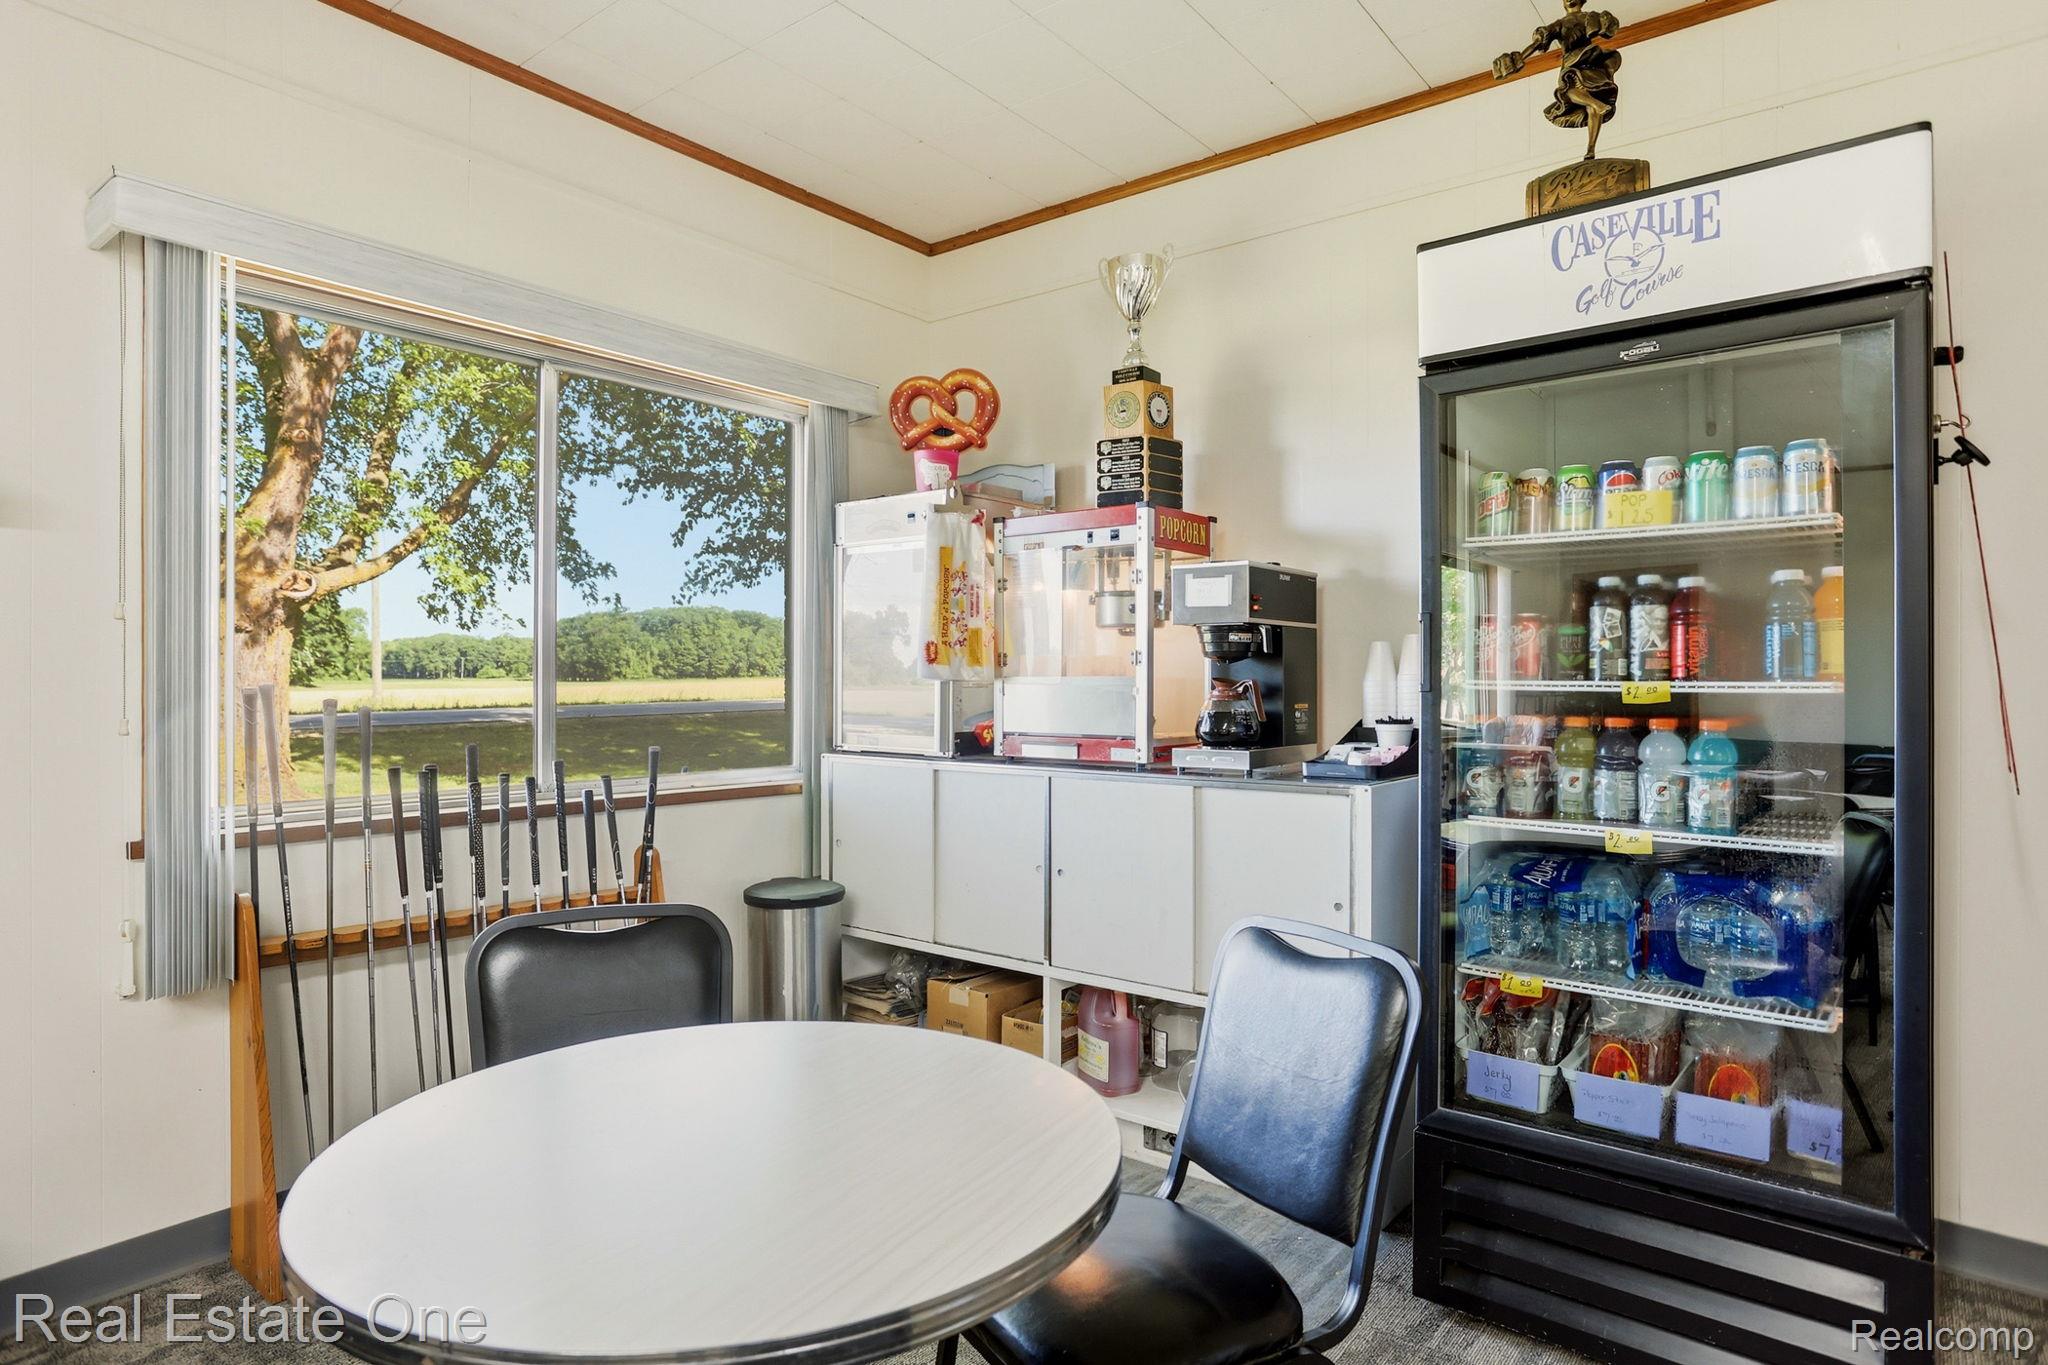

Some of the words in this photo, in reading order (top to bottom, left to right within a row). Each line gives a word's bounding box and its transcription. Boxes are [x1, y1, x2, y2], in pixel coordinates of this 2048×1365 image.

[1551, 189, 1721, 272] CASEVILLE
[1575, 277, 1617, 315] Golf
[1620, 264, 1684, 311] Course
[1621, 494, 1647, 507] POP
[1159, 514, 1206, 547] POPCORN
[1688, 625, 1700, 675] vitamin
[1484, 1065, 1512, 1092] Jerky
